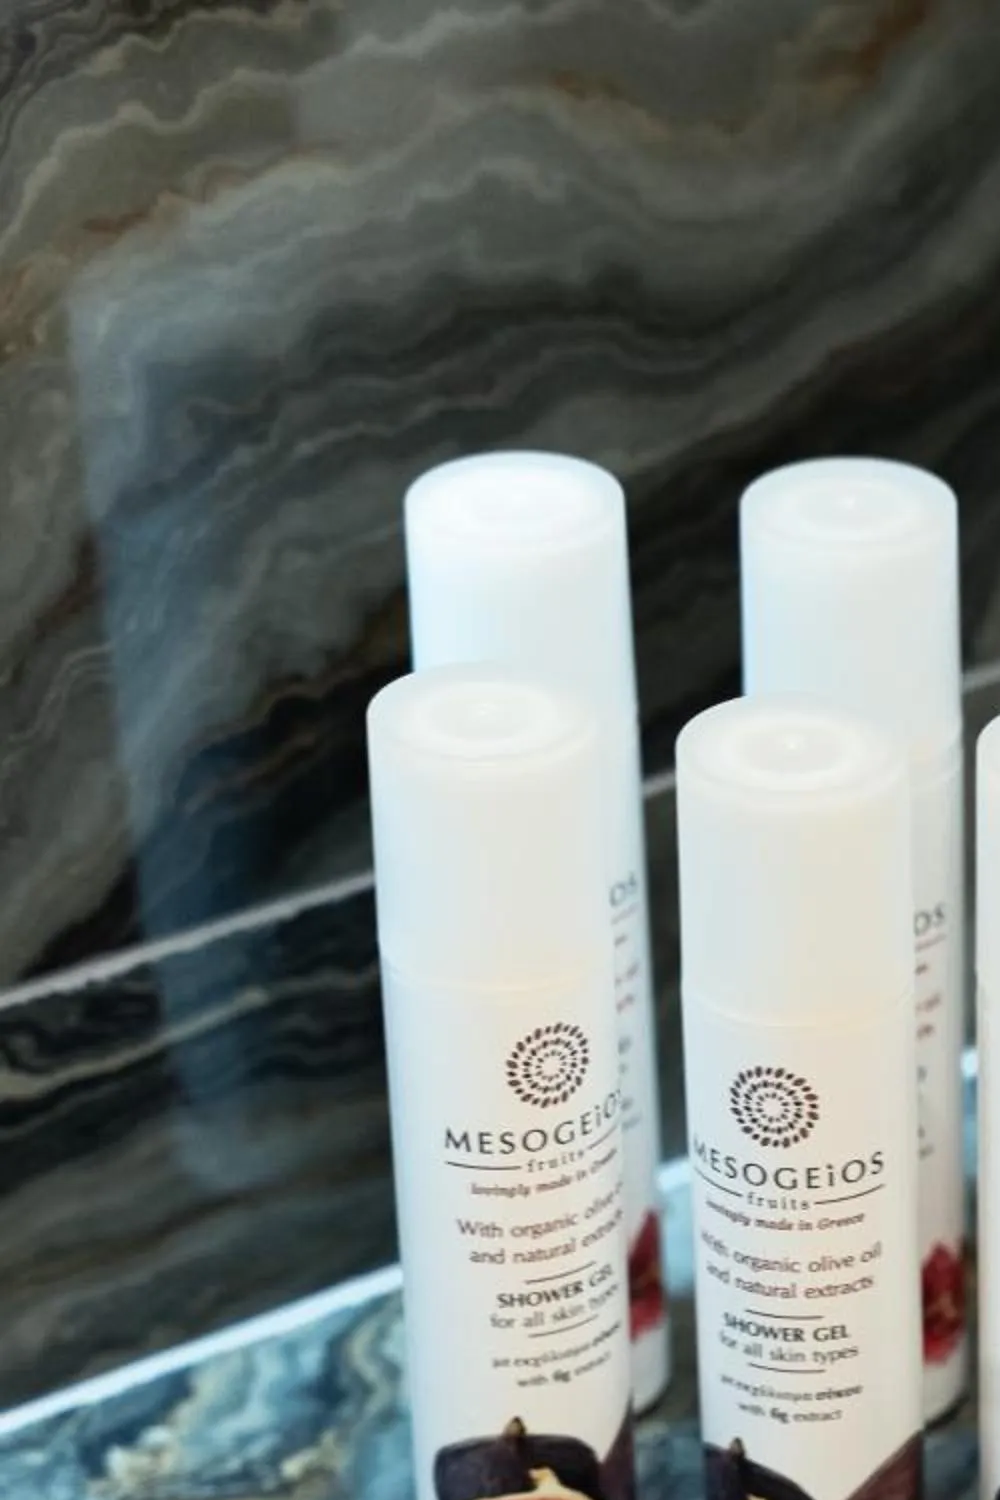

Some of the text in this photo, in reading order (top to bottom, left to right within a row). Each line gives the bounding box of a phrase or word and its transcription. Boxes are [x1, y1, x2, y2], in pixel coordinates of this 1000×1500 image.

[526, 1151, 584, 1172] fruits
[747, 1192, 810, 1210] fruits
[456, 1219, 503, 1238] With
[510, 1213, 578, 1239] organic
[755, 1218, 793, 1230] made
[798, 1218, 813, 1230] in
[817, 1213, 865, 1230] Greece
[469, 1248, 505, 1264] and
[512, 1238, 576, 1263] natural
[733, 1251, 801, 1273] organic
[808, 1254, 855, 1273] olive
[860, 1240, 882, 1262] oil
[496, 1281, 584, 1308] SHOWER
[735, 1277, 797, 1299] natural
[804, 1275, 875, 1299] extracts
[489, 1313, 515, 1328] for
[523, 1311, 545, 1327] all
[553, 1304, 585, 1321] skin
[723, 1312, 851, 1342] SHOWER GEL
[743, 1343, 762, 1358] all
[769, 1347, 806, 1362] skin
[813, 1346, 859, 1364] types
[553, 1370, 572, 1383] fig
[770, 1407, 790, 1424] fig
[793, 1408, 843, 1423] extract
